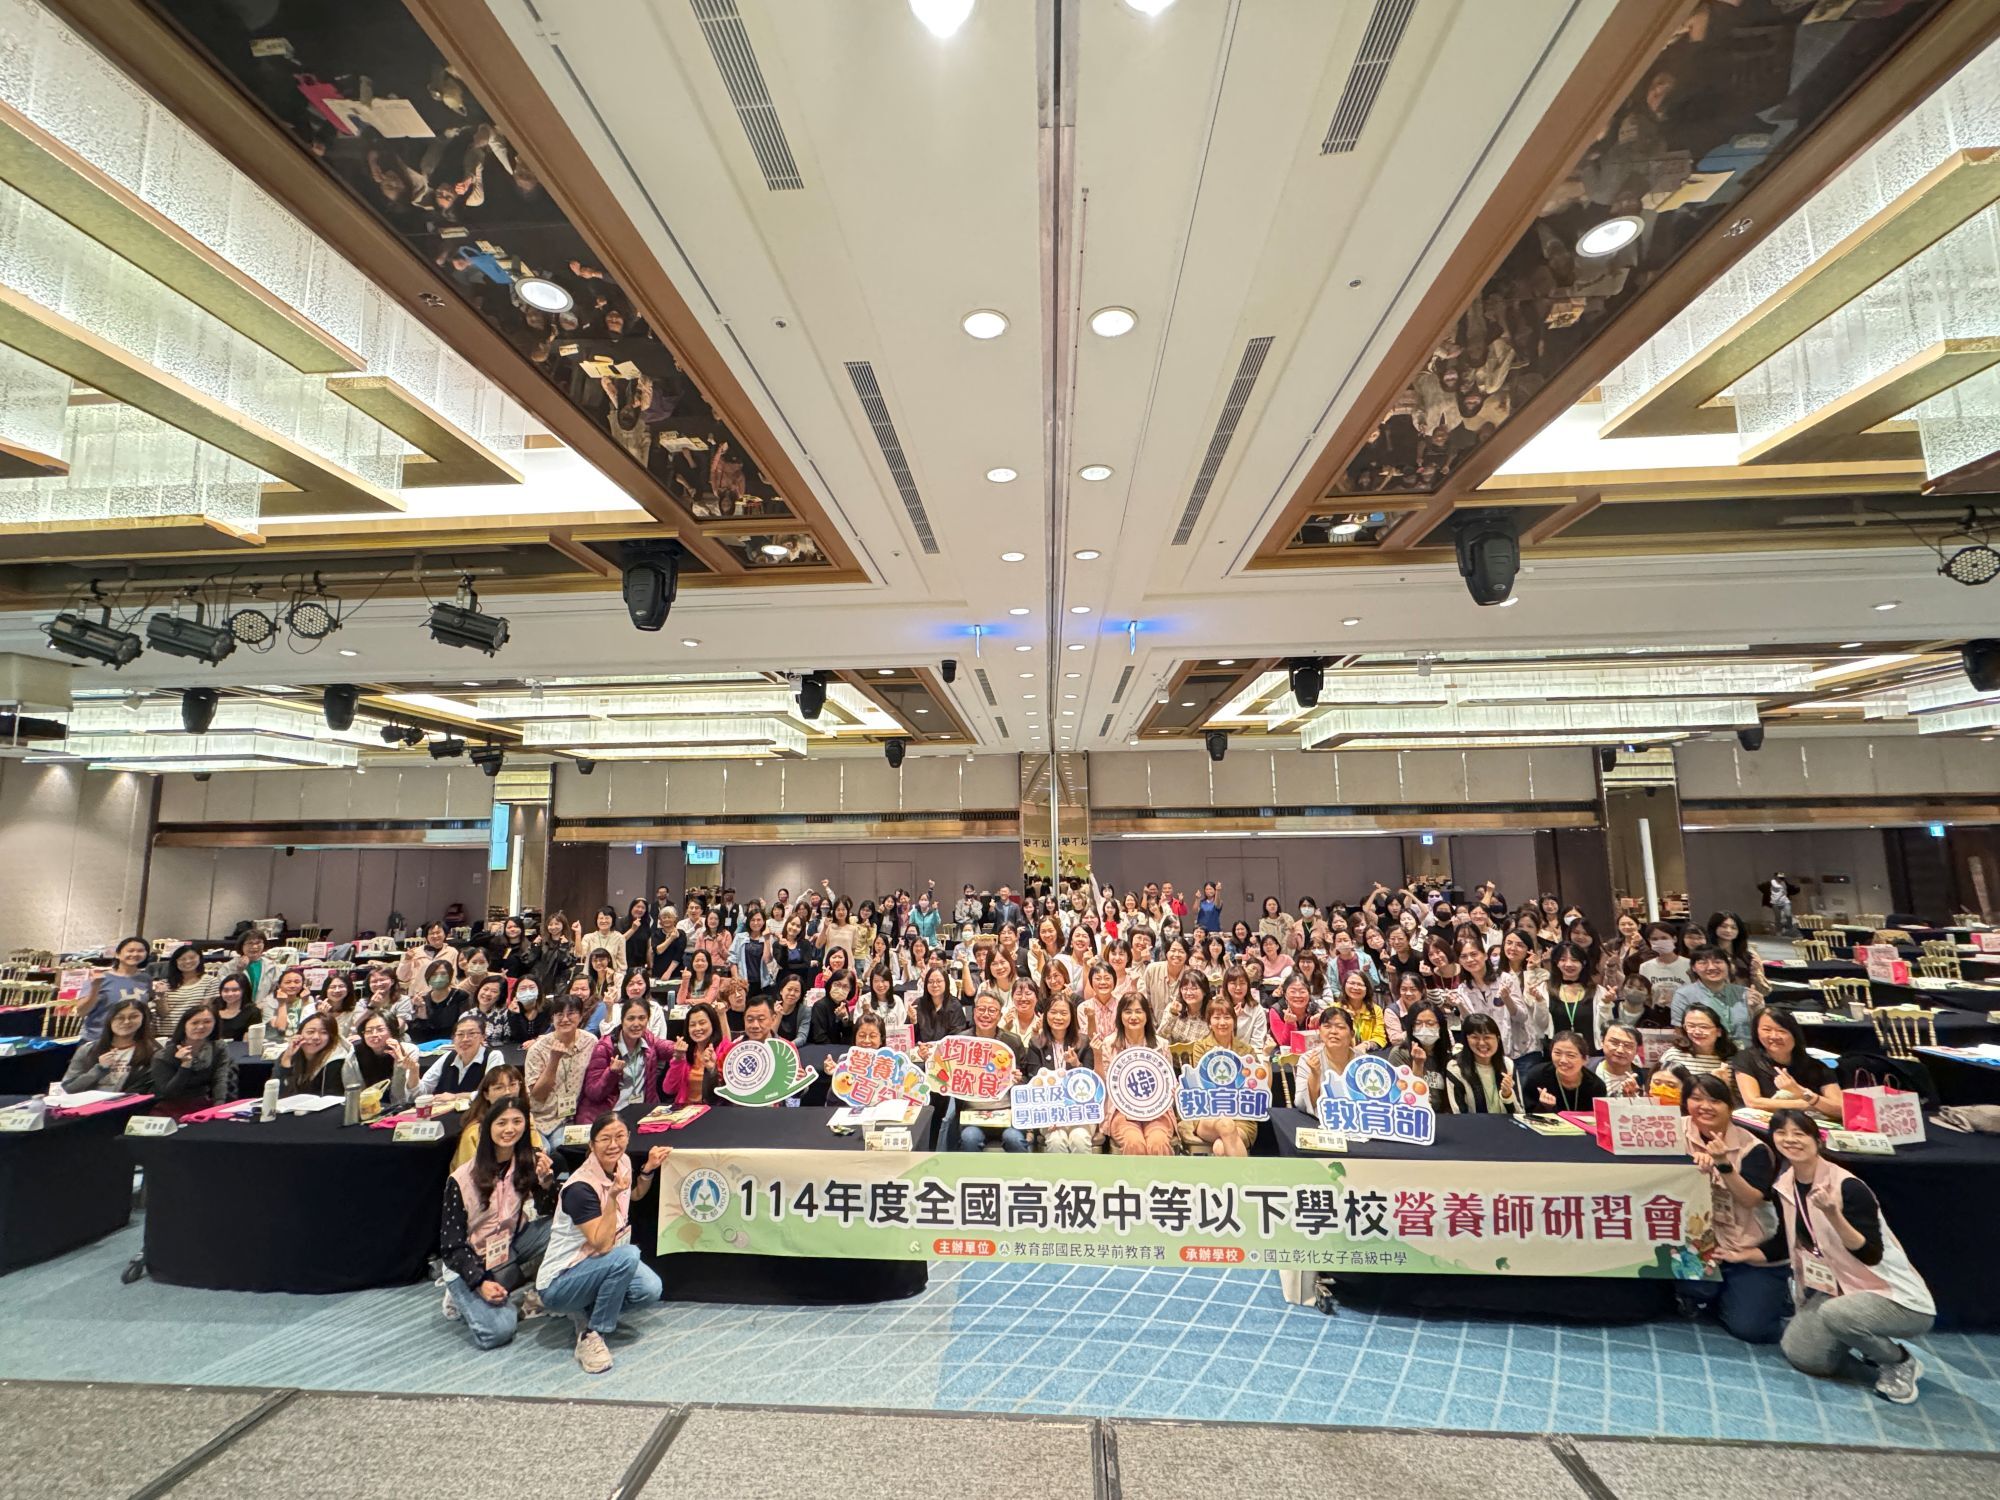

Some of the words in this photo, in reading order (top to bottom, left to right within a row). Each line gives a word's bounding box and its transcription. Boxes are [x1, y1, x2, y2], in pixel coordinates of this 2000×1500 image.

[943, 1039, 992, 1067] 均衡
[849, 1050, 895, 1081] 營養
[951, 1068, 999, 1098] 飲食
[1015, 1087, 1063, 1104] 國民及
[1180, 1089, 1268, 1116] 教育部
[1016, 1104, 1101, 1125] 學前教育署
[1323, 1100, 1429, 1138] 教育部
[683, 1175, 697, 1208] MINISTRY
[708, 1171, 726, 1209] EDUCATION
[939, 1240, 990, 1256] 主辦單位
[1014, 1241, 1166, 1260] 教育部國民及學前教育署
[1185, 1248, 1239, 1262] 承辦學校
[1264, 1249, 1408, 1266] 國立彰化女子高級中學
